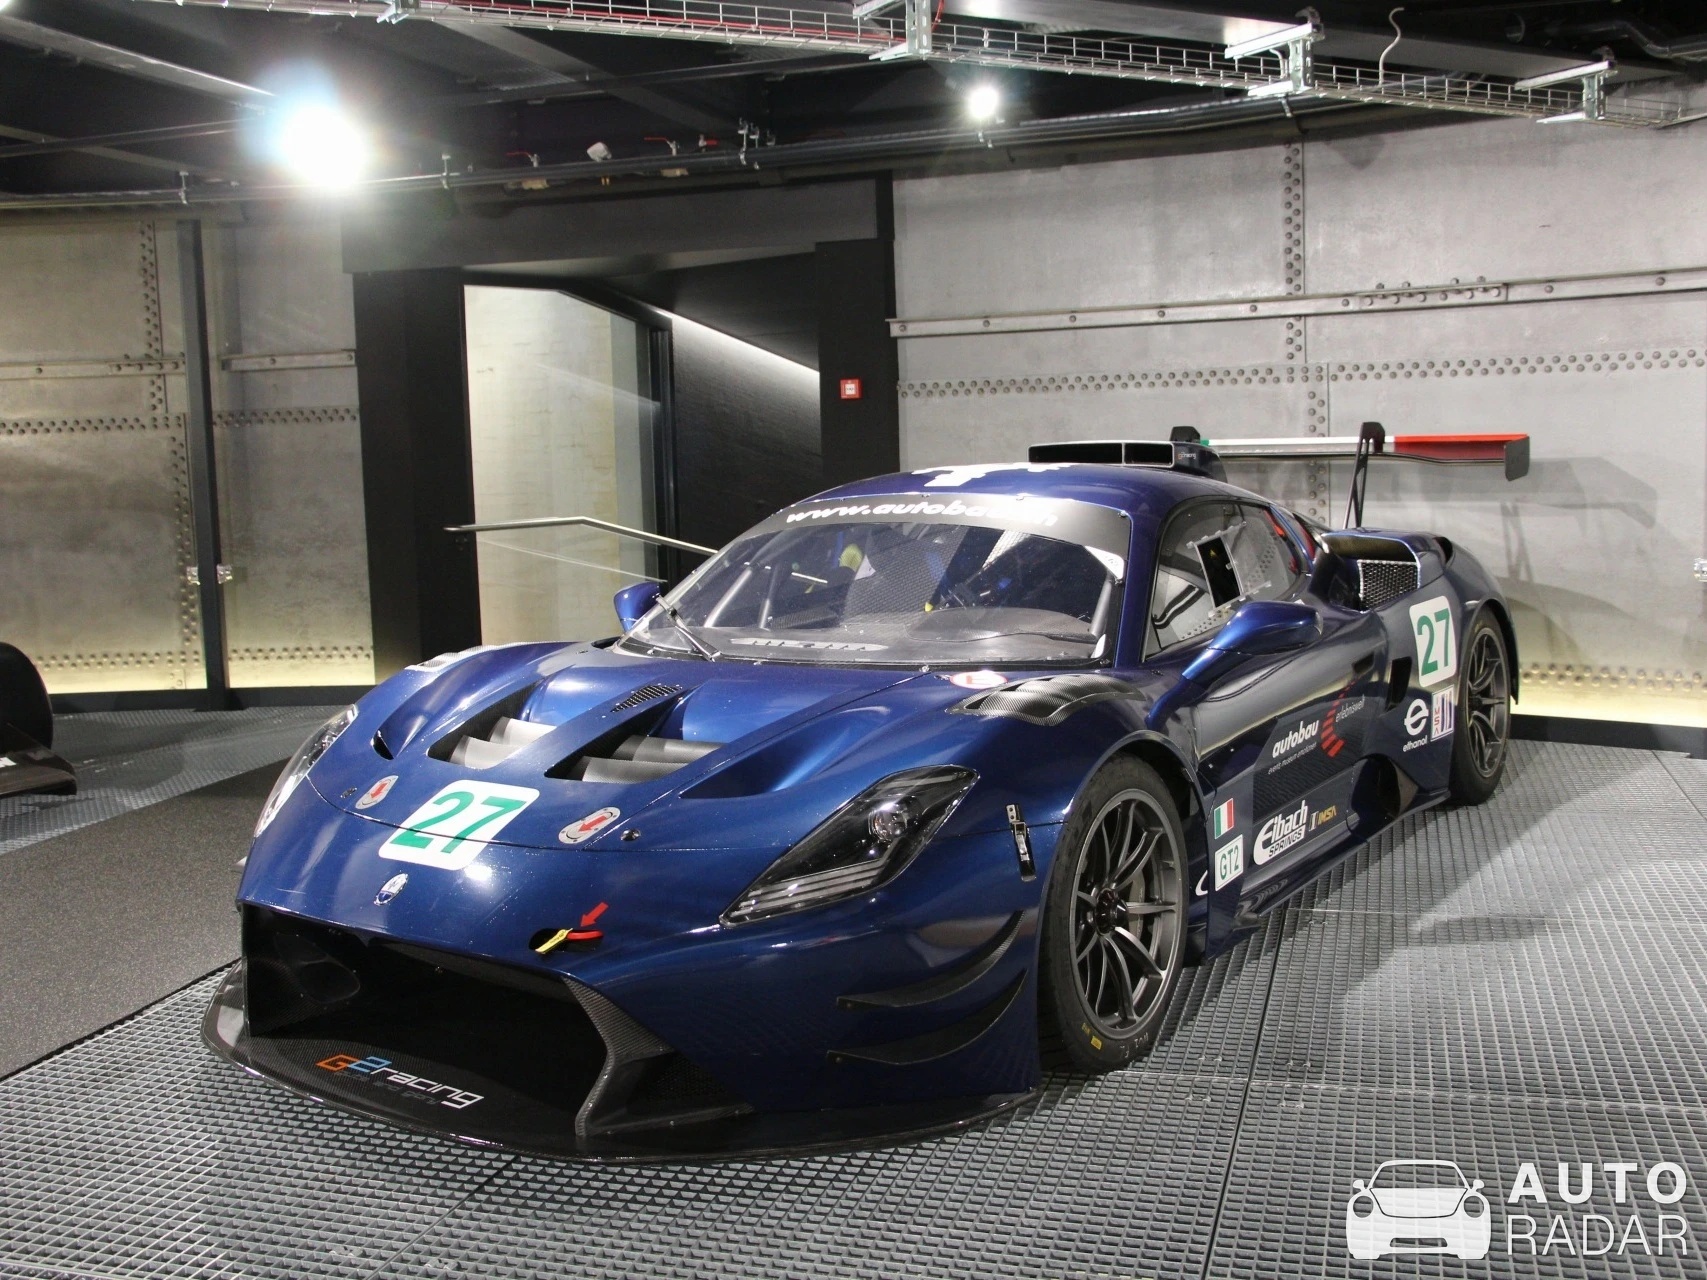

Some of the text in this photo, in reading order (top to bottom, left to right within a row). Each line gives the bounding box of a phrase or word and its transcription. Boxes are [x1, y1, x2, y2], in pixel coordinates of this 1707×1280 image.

[787, 500, 1058, 526] www.autobauh
[1417, 608, 1450, 676] 27
[1272, 720, 1320, 758] autobau
[1402, 735, 1428, 752] ethanol
[389, 791, 528, 854] 27
[1253, 800, 1308, 865] Eibach
[1268, 828, 1302, 858] SPRINGS
[1220, 845, 1239, 880] GT2
